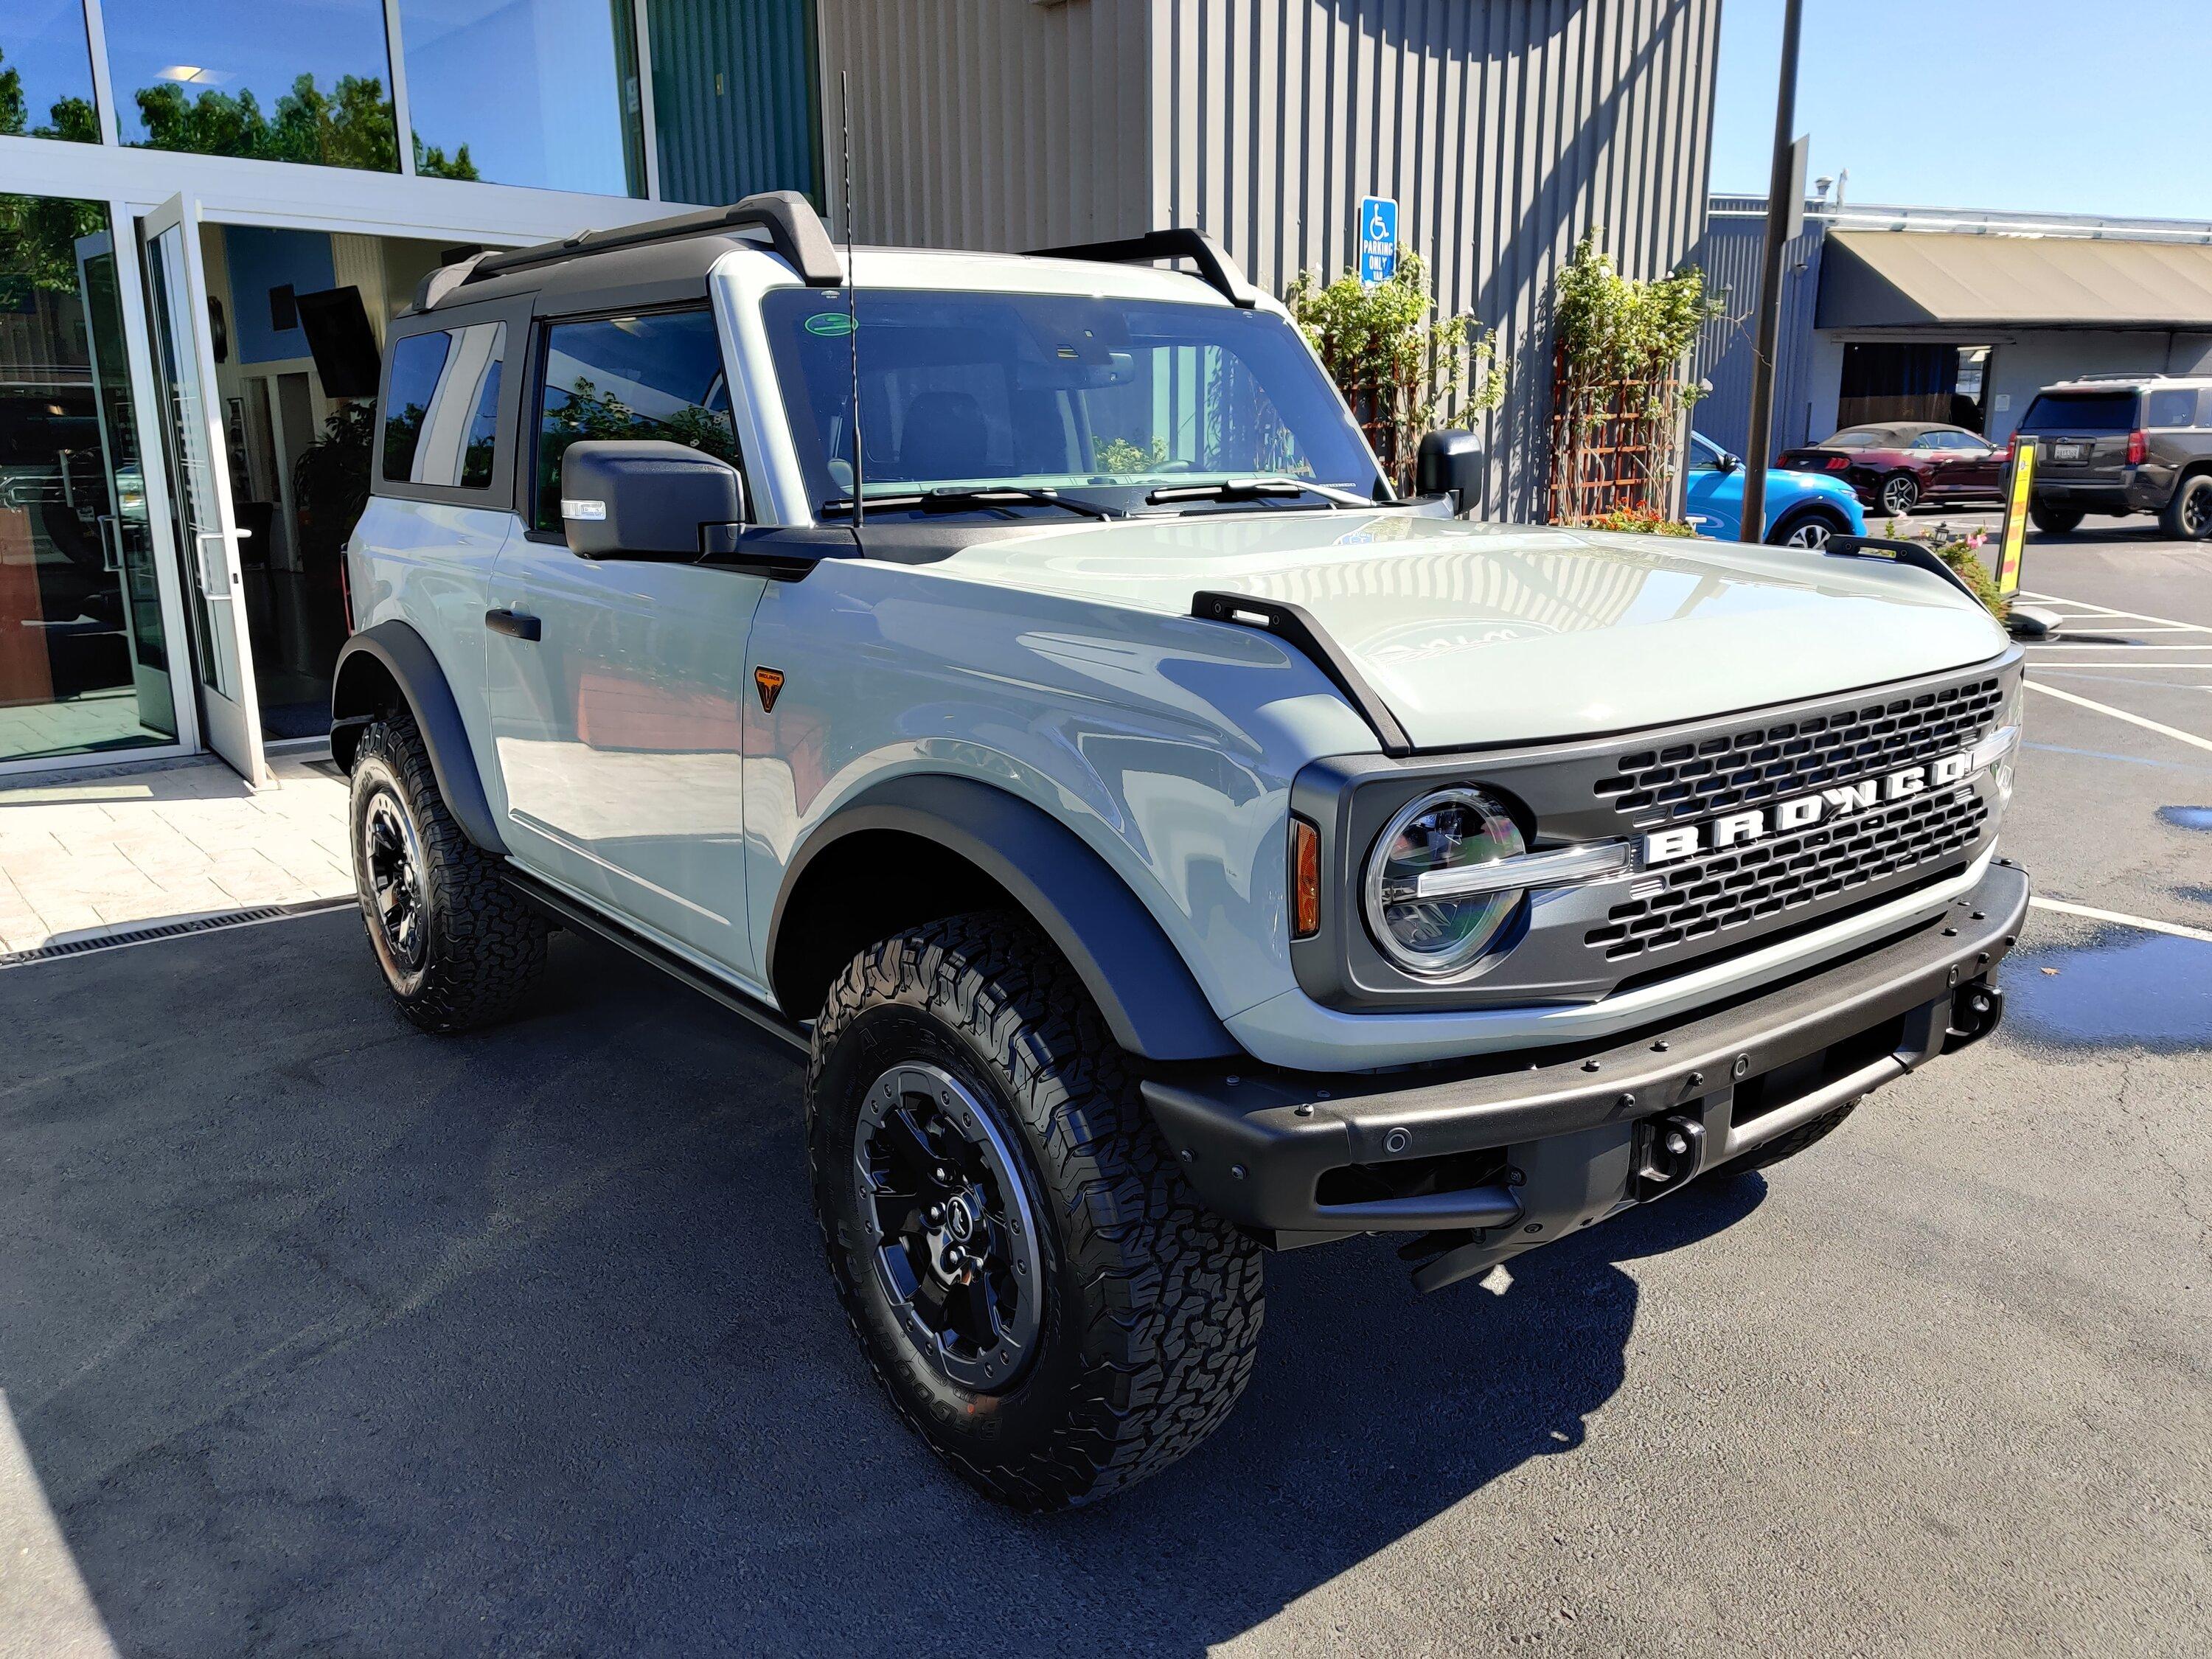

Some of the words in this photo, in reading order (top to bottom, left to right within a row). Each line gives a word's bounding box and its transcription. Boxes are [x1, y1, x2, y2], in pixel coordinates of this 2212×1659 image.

[1364, 239, 1394, 257] PARKING
[1369, 255, 1388, 271] ONLY
[1643, 752, 1966, 866] BRONCO
